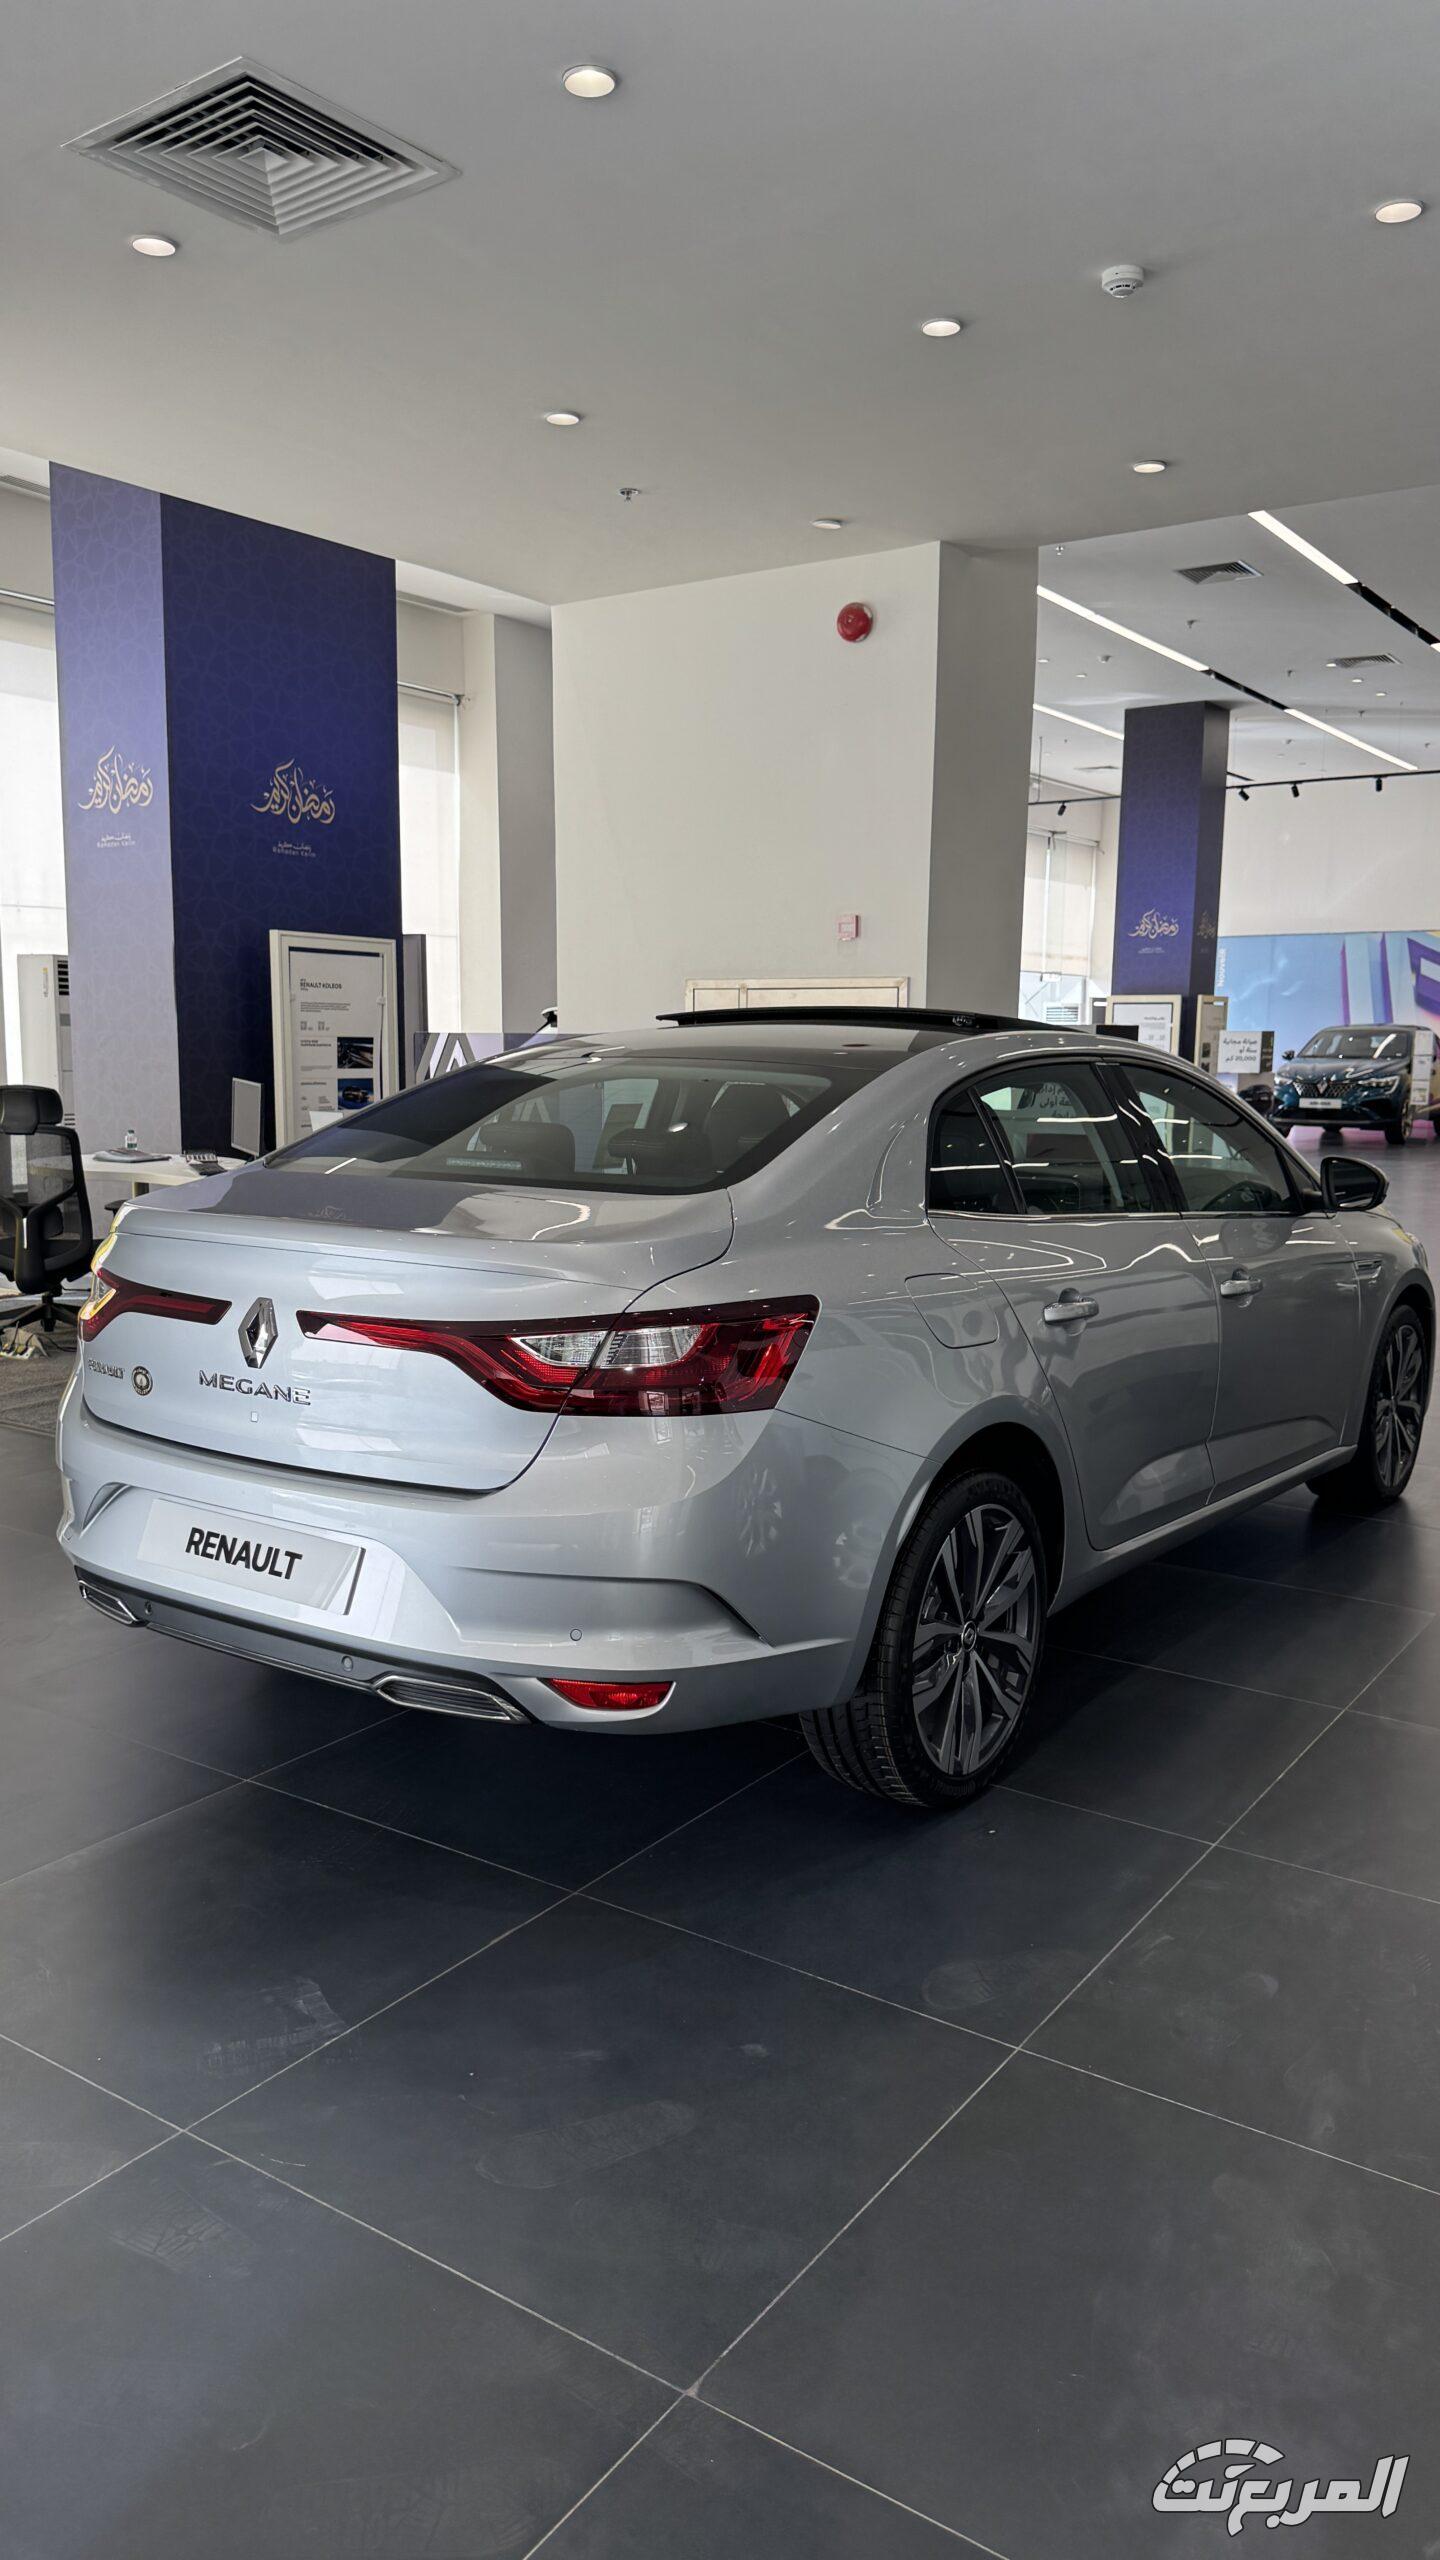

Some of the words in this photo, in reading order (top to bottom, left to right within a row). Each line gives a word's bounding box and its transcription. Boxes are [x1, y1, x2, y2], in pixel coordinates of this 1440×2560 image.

[77, 745, 115, 810] كريم
[108, 752, 153, 814] رمضان
[250, 758, 295, 815] كريم
[287, 766, 335, 824] رمضان
[198, 1370, 312, 1406] MEGANE
[185, 1527, 303, 1580] RENAULT
